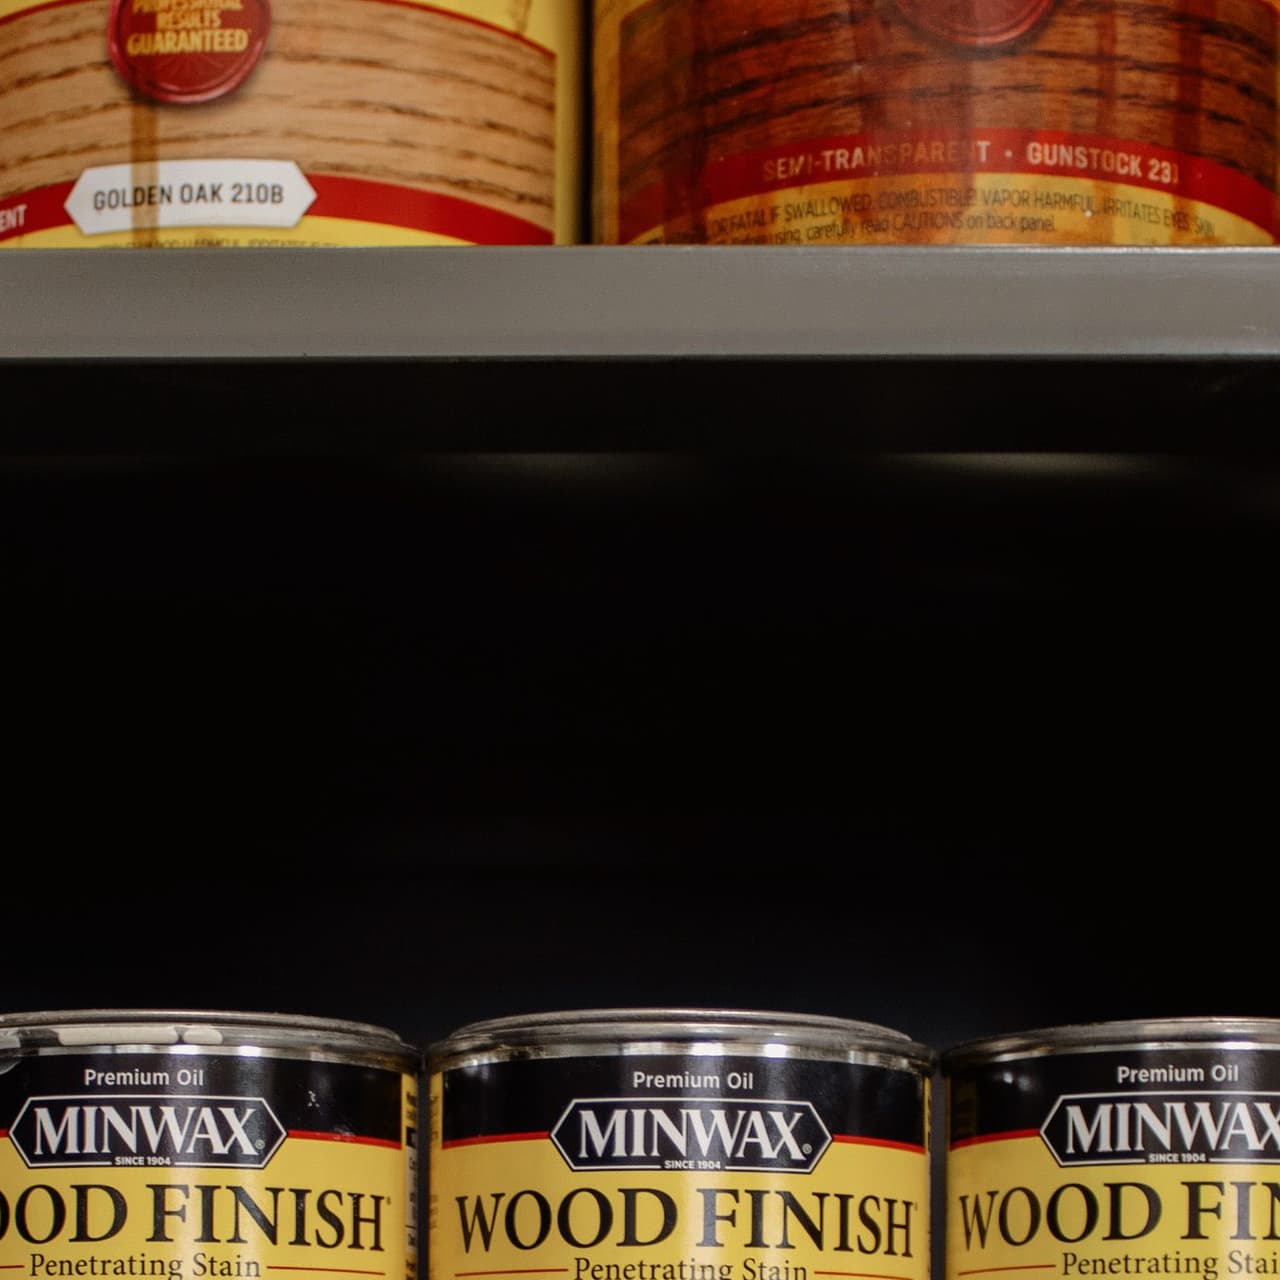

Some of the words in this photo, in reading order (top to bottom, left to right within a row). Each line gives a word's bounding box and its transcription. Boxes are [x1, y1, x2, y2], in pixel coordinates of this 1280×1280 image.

[157, 9, 221, 29] RESULTS
[128, 29, 248, 55] GUARANTEED
[1027, 142, 1141, 177] GUNSTOCK
[94, 184, 172, 210] GOLDEN
[181, 184, 223, 202] OAK
[232, 184, 283, 203] 210B
[85, 1069, 169, 1086] Premium
[177, 1069, 204, 1086] Oil
[34, 1106, 259, 1156] MINWAX
[580, 1109, 806, 1160] MINWAX
[146, 1184, 385, 1252] FINISH
[456, 1188, 678, 1254] WOOD
[696, 1188, 914, 1258] FINISH
[959, 1182, 1161, 1252] WOOD
[193, 1254, 261, 1278] Stain
